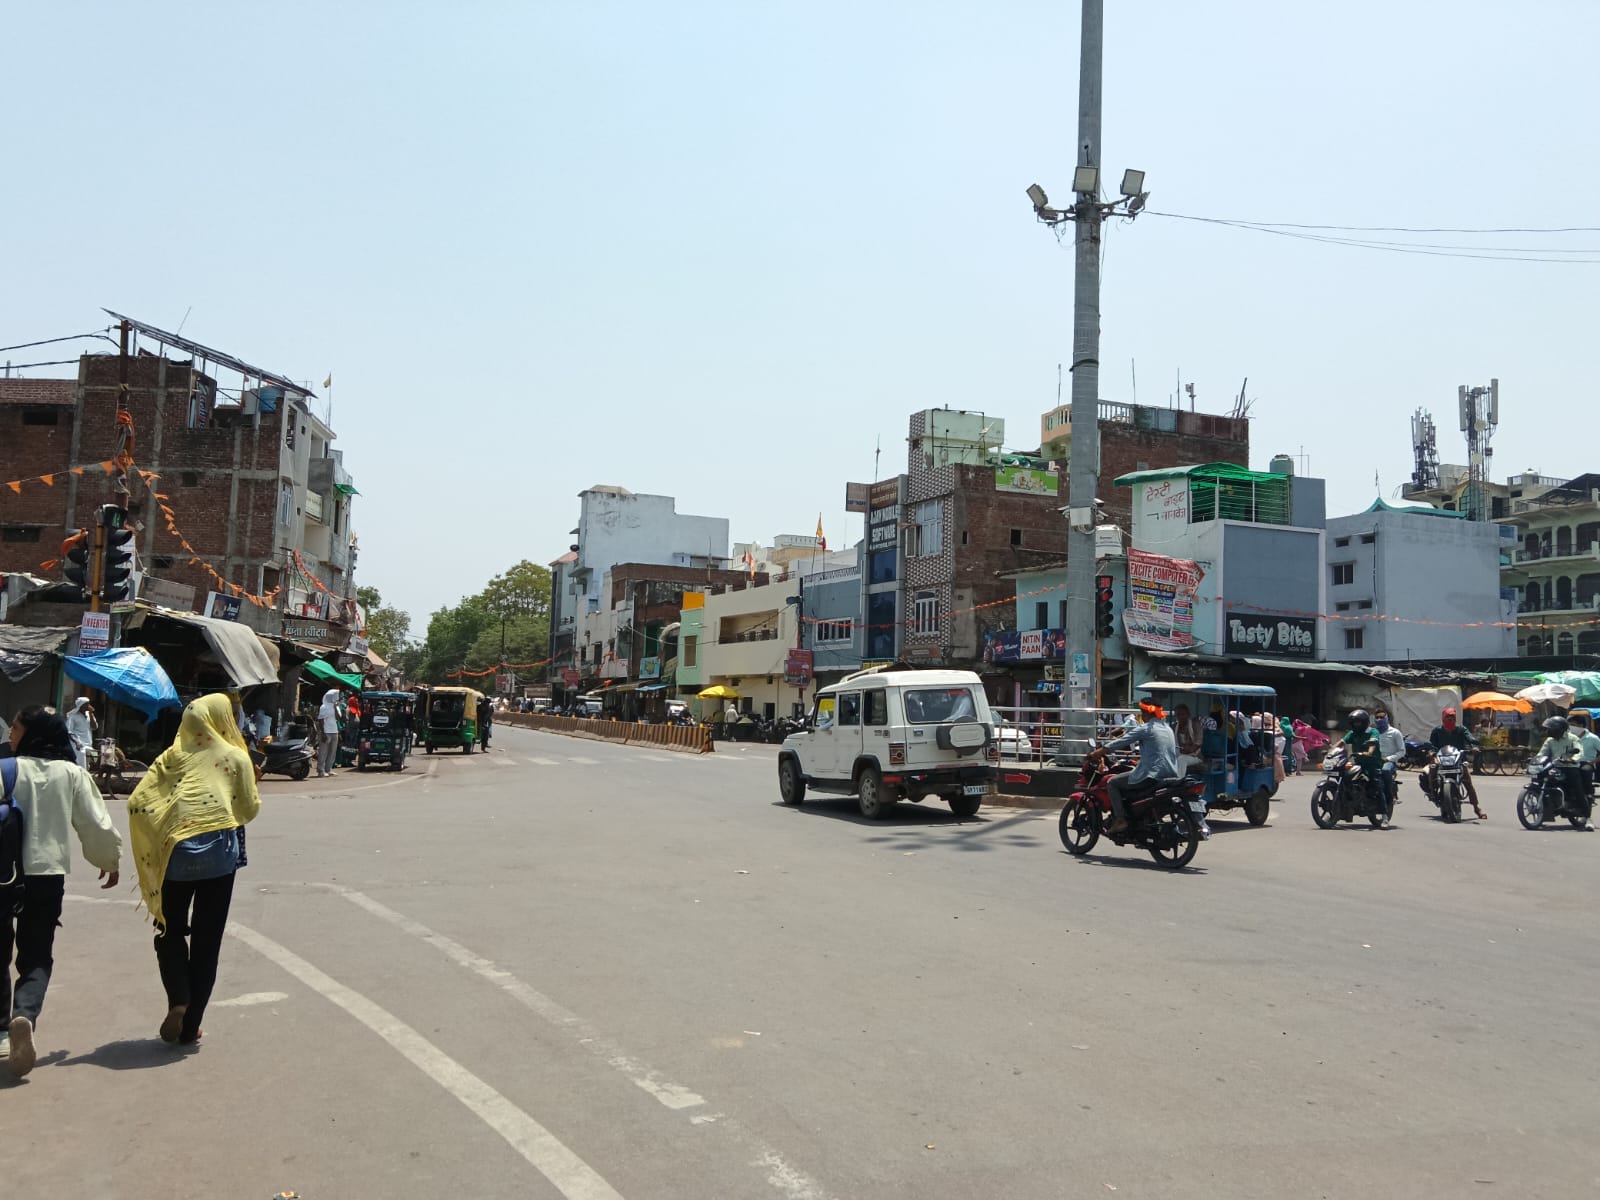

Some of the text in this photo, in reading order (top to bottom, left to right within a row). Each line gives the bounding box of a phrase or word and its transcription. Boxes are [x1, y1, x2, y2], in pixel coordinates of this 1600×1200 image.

[1130, 562, 1151, 578] EXCITE
[1152, 566, 1188, 584] COMPUTER
[1022, 634, 1041, 644] NITIN
[1229, 619, 1312, 649] Tasty Bite
[1021, 645, 1041, 655] PAAN
